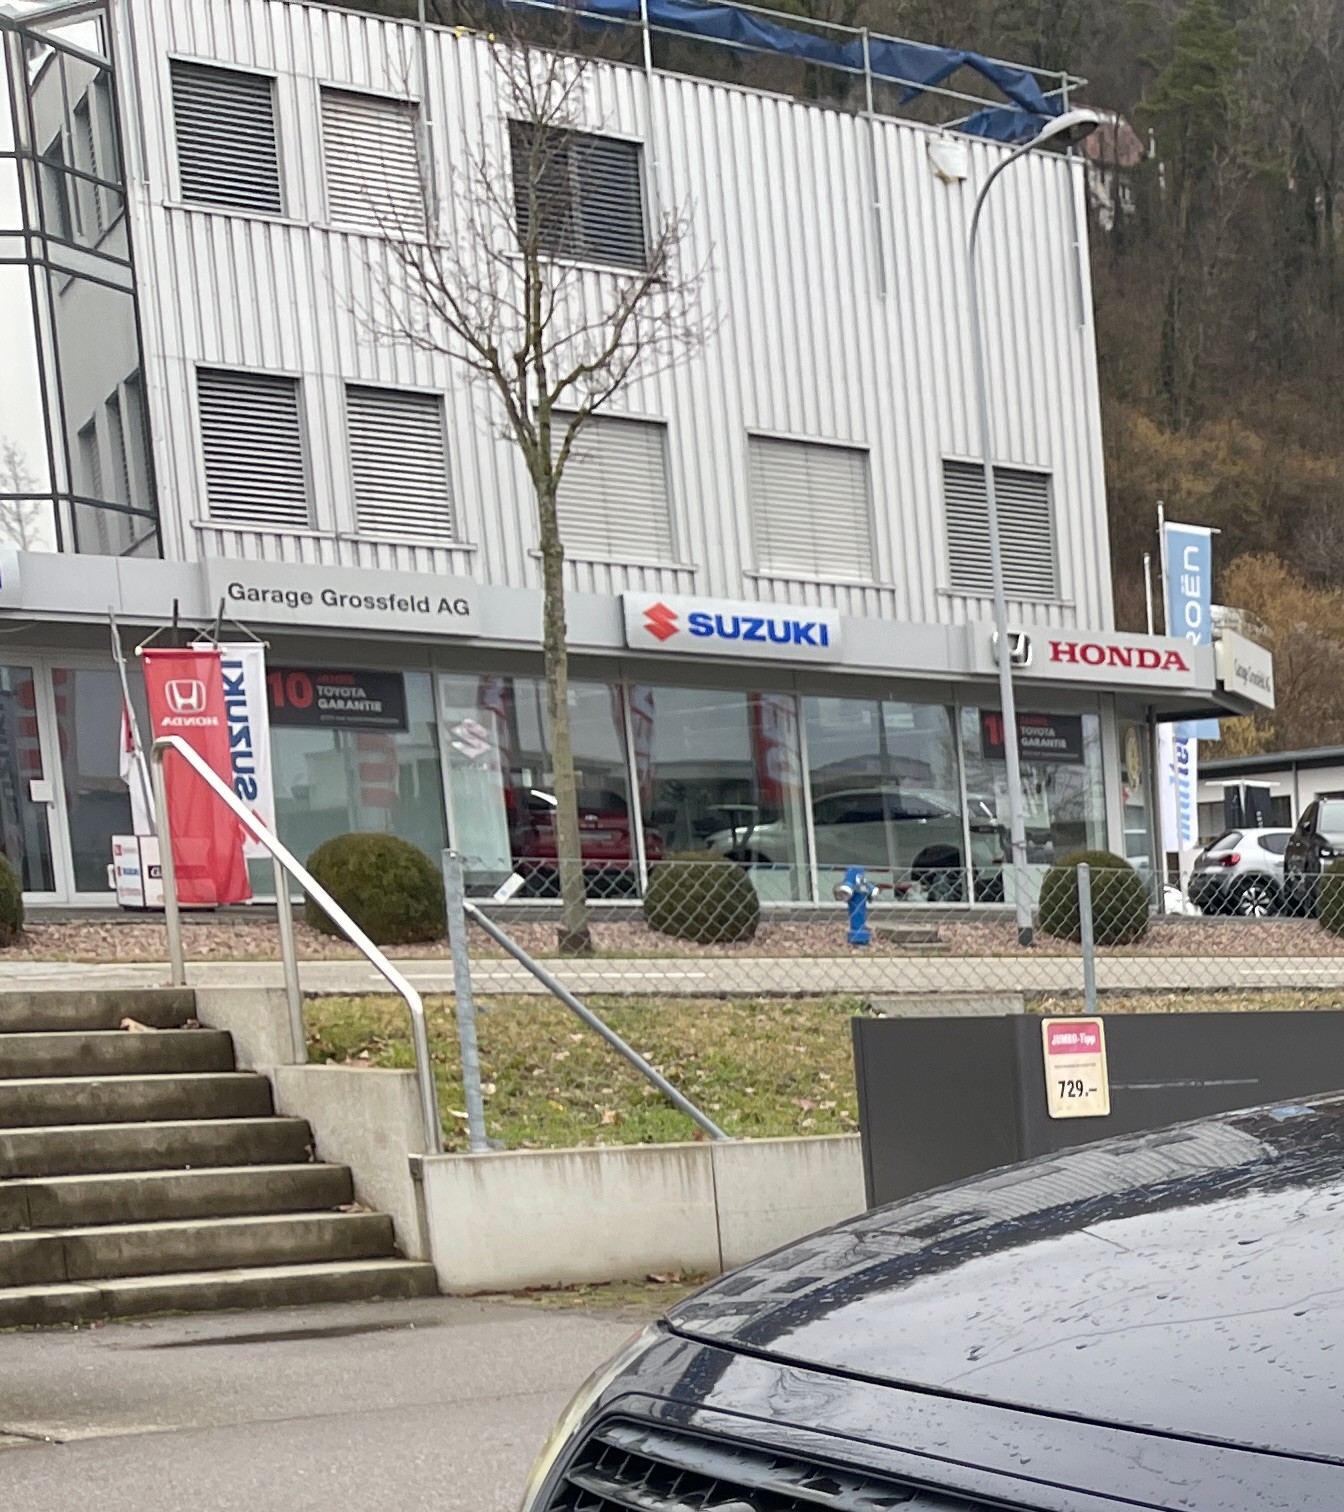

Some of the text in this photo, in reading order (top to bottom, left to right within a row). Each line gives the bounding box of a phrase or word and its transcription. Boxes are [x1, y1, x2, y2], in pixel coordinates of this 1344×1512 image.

[227, 582, 470, 616] Garage Grossfeld AG
[687, 611, 829, 647] SUZUKI
[1048, 640, 1190, 672] HONDA
[267, 671, 314, 709] 10
[316, 685, 367, 698] TOYOTA
[317, 698, 382, 713] GARANTIE
